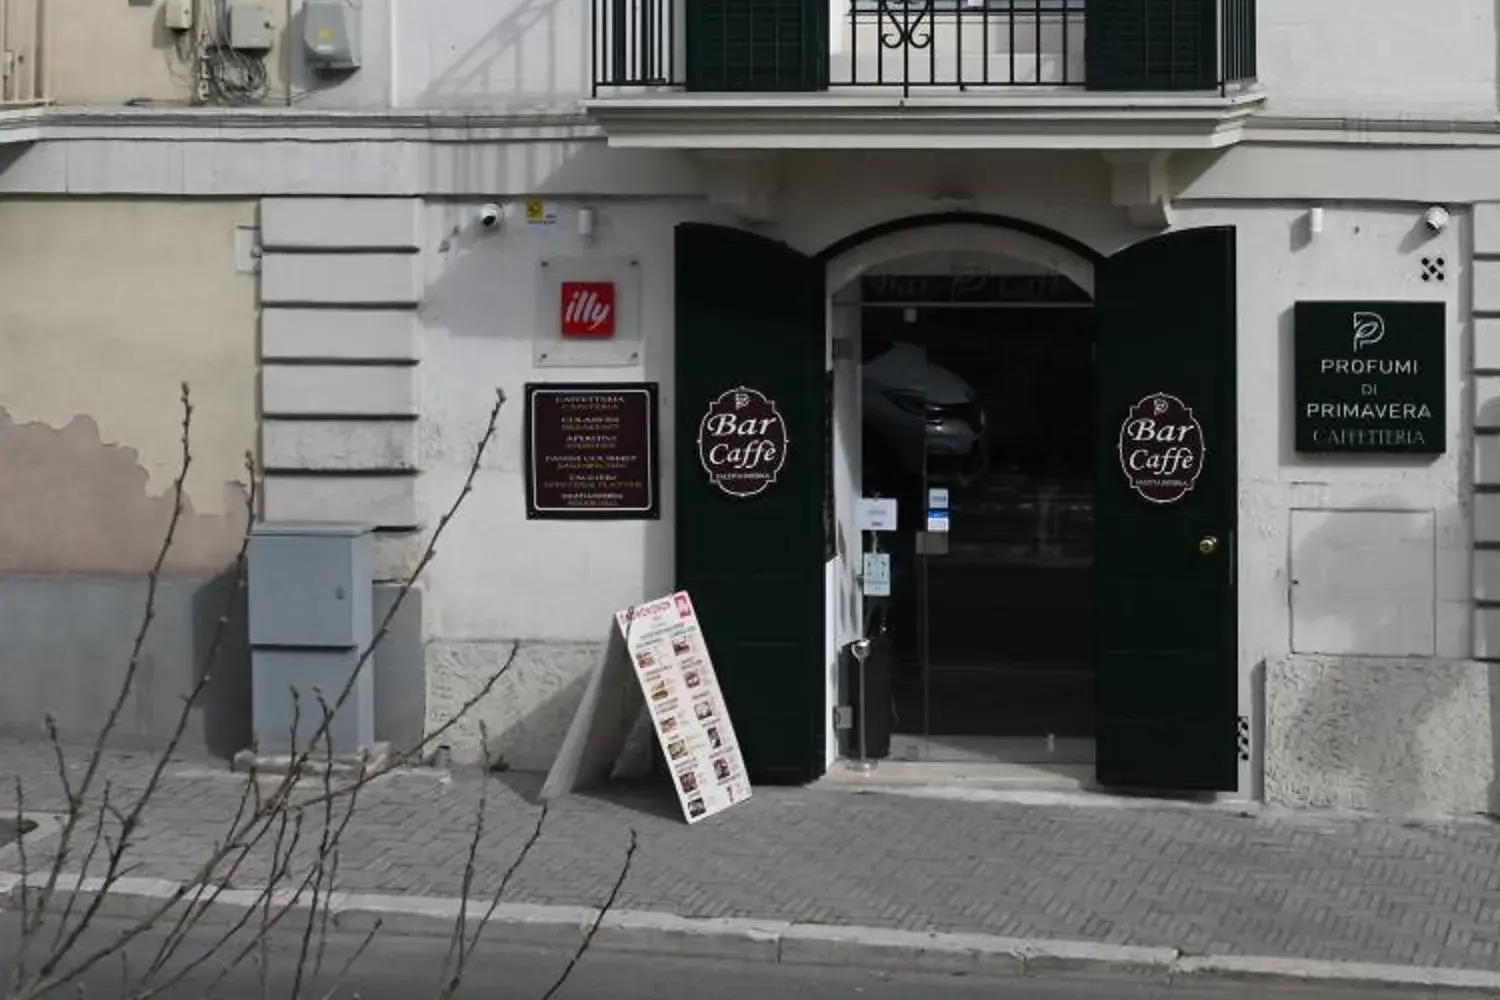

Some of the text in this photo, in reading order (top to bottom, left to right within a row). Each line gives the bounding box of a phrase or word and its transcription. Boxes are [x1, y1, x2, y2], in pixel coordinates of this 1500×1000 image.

[565, 290, 611, 331] illy
[1320, 359, 1418, 375] PROFUMI
[1361, 383, 1377, 396] DI
[1306, 403, 1431, 420] PRIMAVERA
[707, 413, 777, 436] Bar
[1127, 418, 1195, 442] Bar
